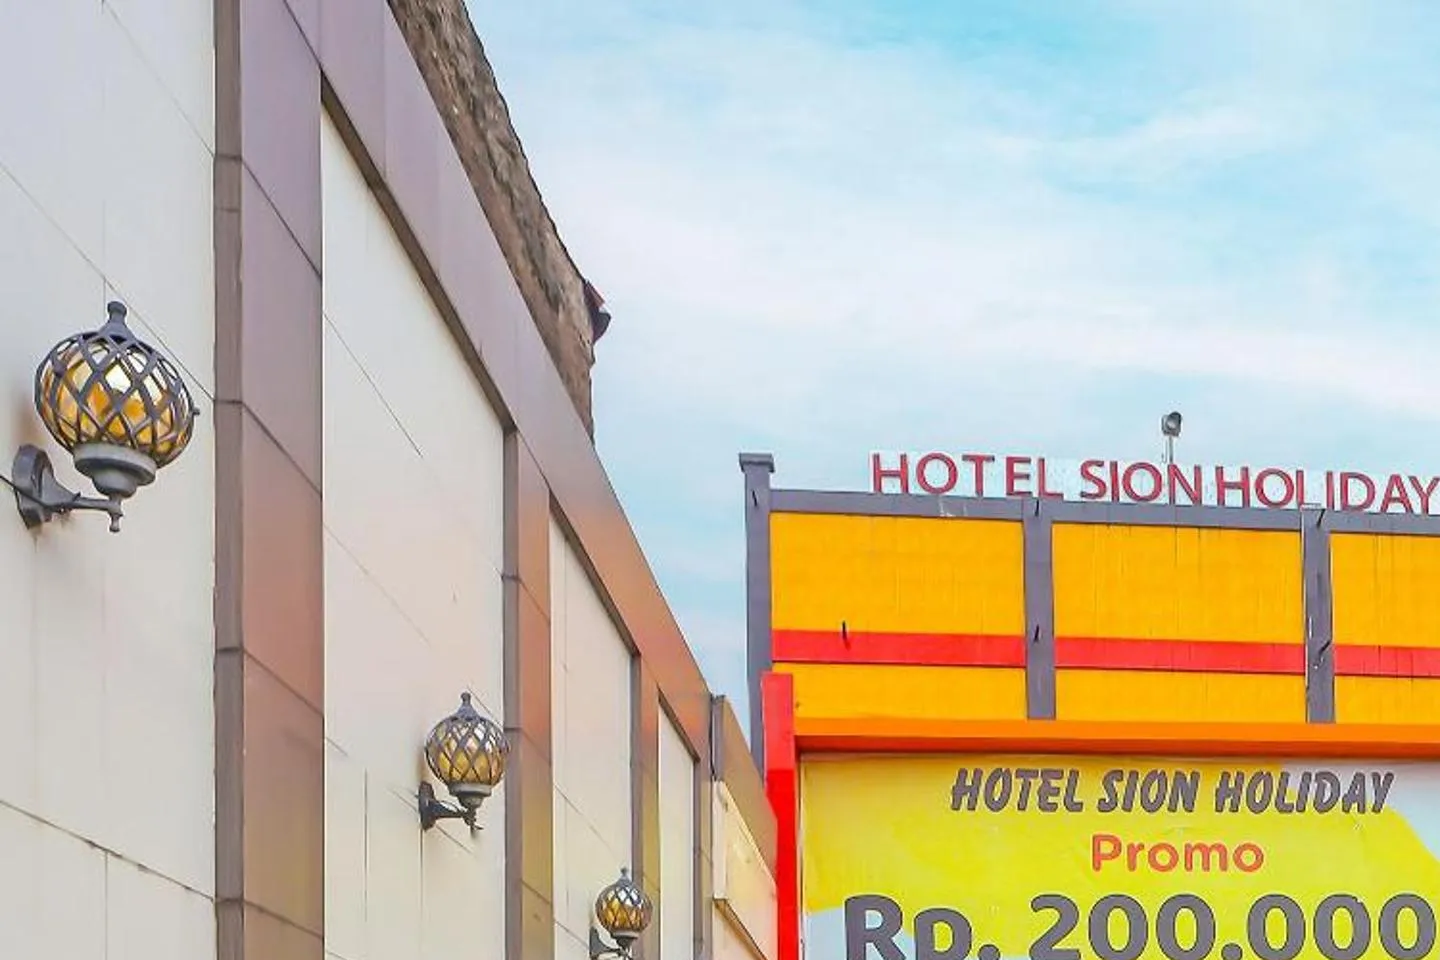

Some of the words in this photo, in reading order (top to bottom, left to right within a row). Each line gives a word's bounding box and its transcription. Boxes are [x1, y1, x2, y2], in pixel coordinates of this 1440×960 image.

[872, 453, 1064, 500] HOTEL
[1080, 459, 1201, 506] SION
[1215, 466, 1440, 514] HOLIDAY
[950, 767, 1084, 813] HOTEL
[1097, 769, 1201, 814] SION
[1214, 770, 1395, 815] HOLIDAY
[1091, 834, 1265, 873] Promo
